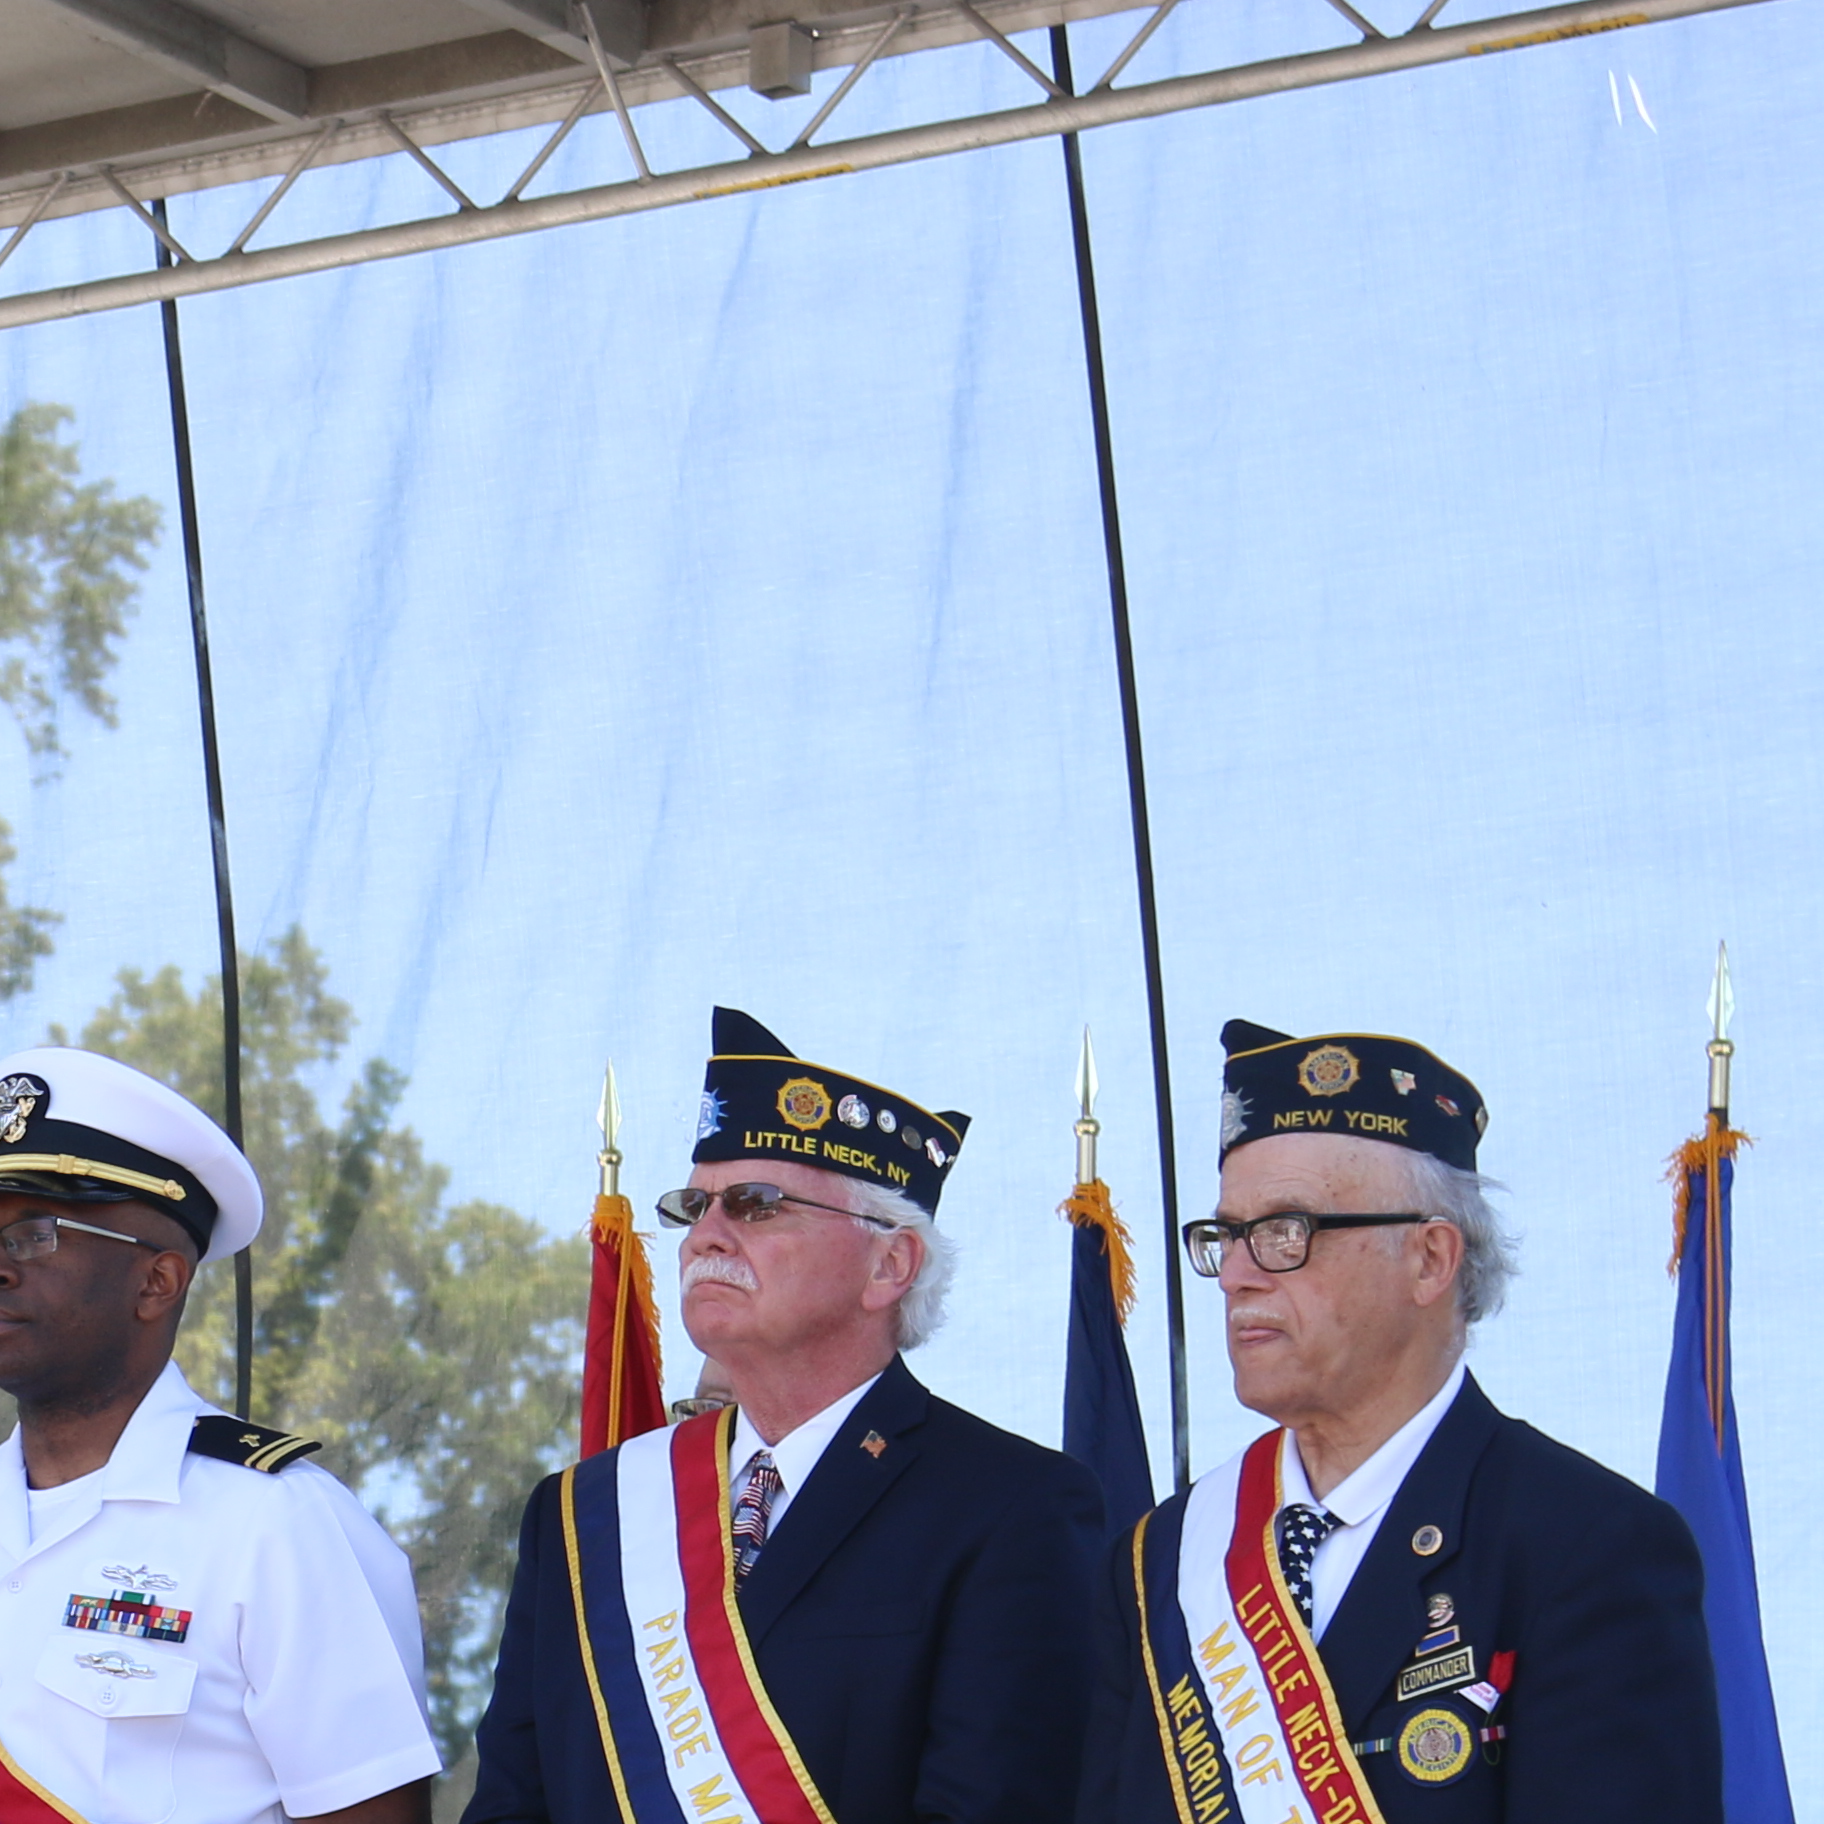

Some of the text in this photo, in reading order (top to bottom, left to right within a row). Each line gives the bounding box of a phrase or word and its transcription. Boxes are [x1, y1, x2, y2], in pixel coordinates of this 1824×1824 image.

[744, 1130, 910, 1187] LITTLE NECK, NY
[1274, 1109, 1408, 1136] NEW YORK
[1236, 1584, 1300, 1703] LITTLE
[1403, 1656, 1468, 1691] COMMANDER
[642, 1610, 712, 1768] PARADE
[1199, 1622, 1260, 1727] MAN
[1236, 1734, 1283, 1788] OF
